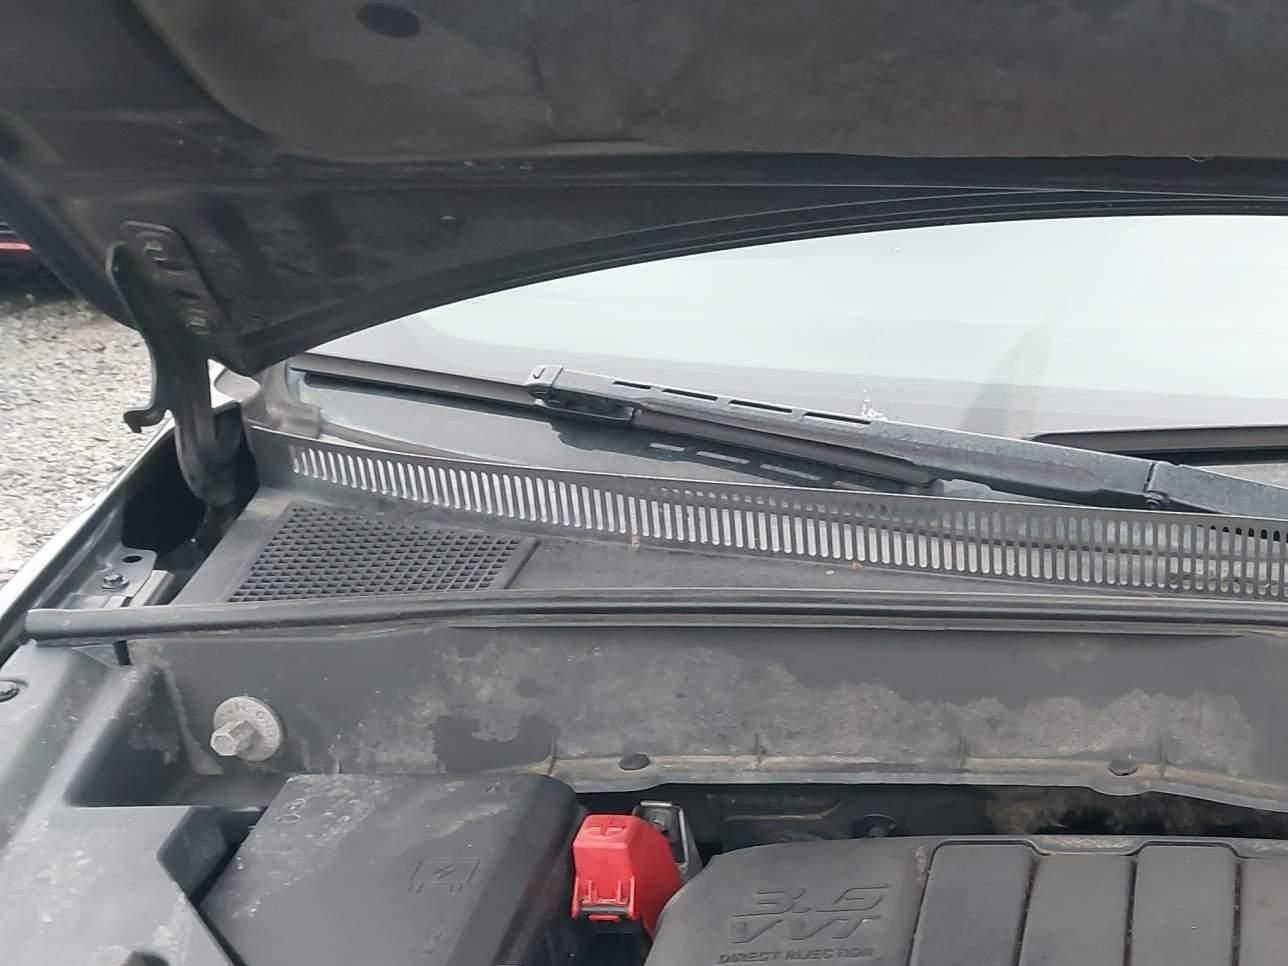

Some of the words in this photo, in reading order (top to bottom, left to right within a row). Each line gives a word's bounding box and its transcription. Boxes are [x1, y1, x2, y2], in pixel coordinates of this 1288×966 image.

[730, 916, 882, 944] VVT
[716, 951, 781, 964] DIRECT
[785, 947, 877, 961] INJECTION
